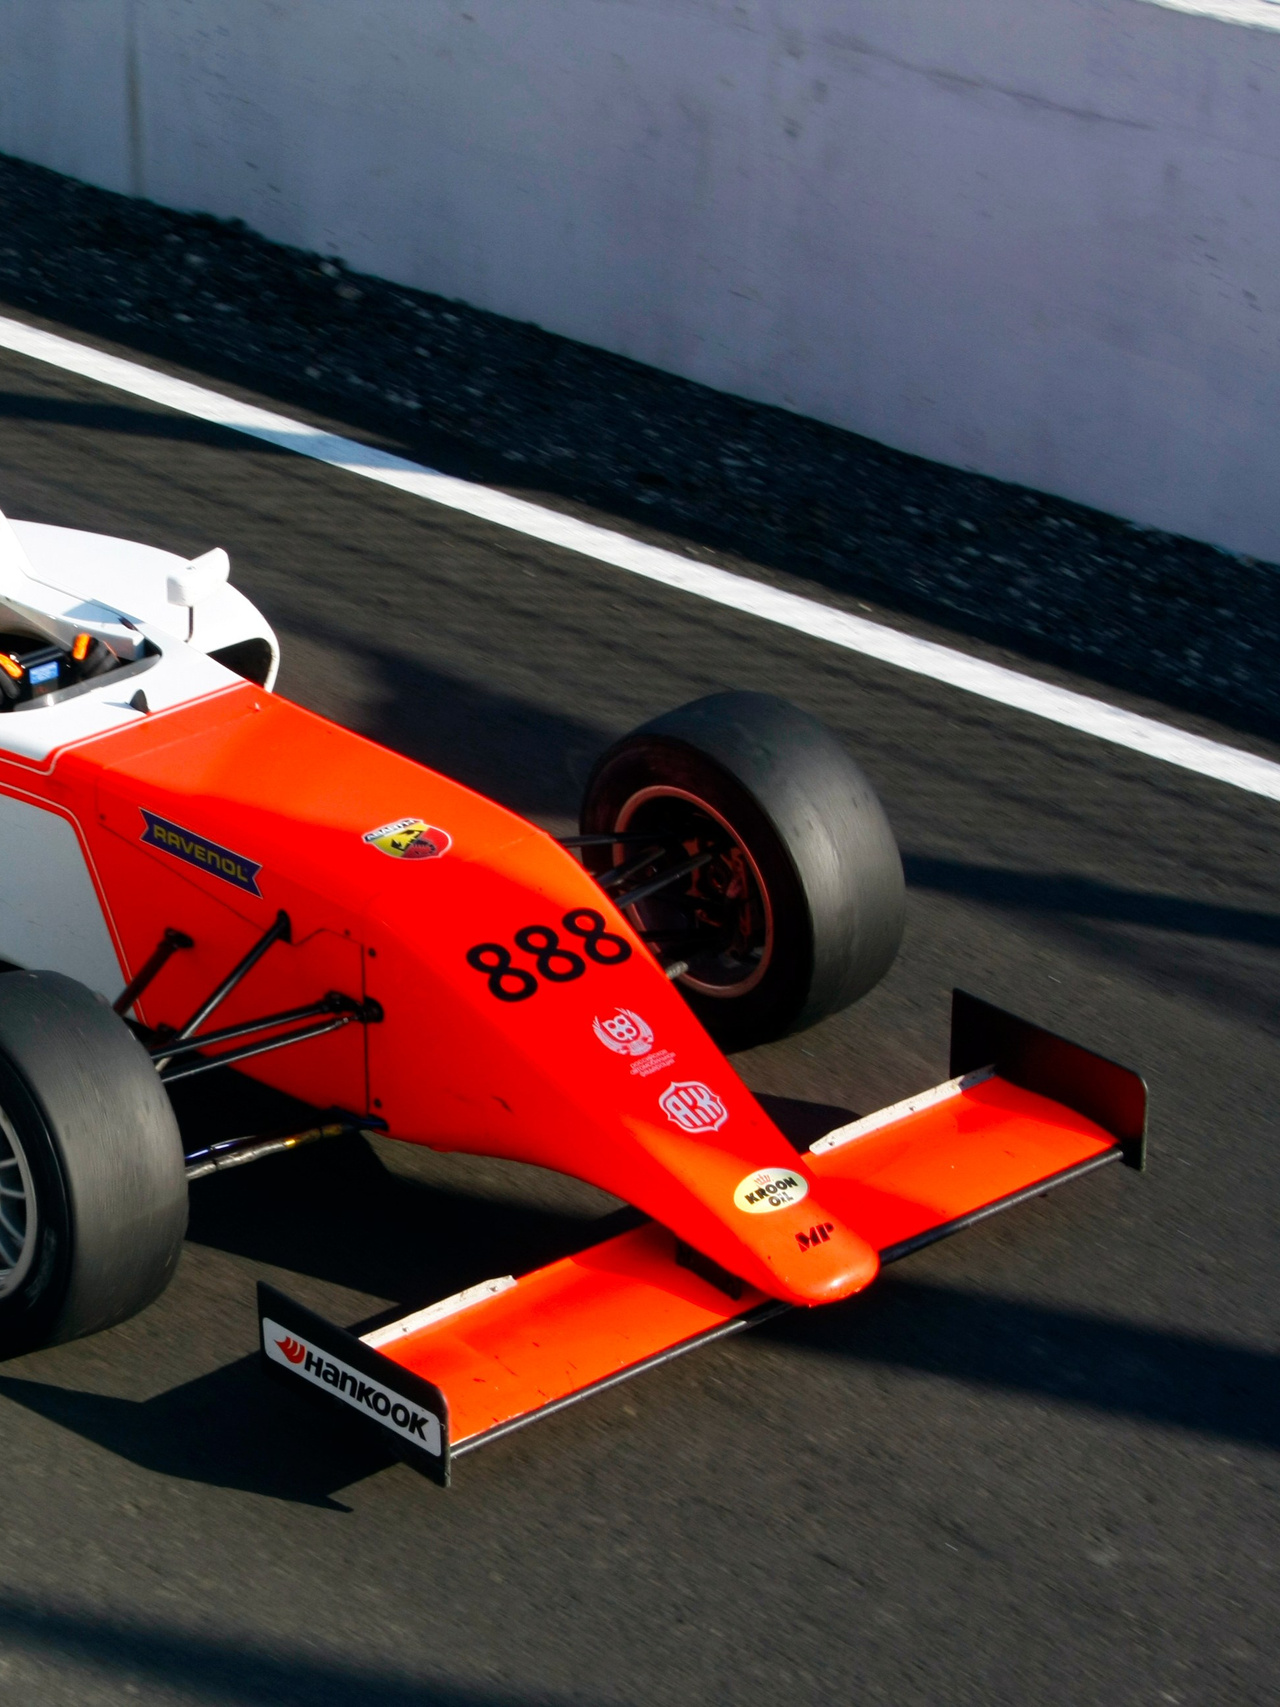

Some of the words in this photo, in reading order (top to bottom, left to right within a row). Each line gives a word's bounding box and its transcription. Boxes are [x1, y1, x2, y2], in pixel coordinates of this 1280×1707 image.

[153, 823, 249, 883] RAVENOL
[465, 907, 633, 1003] 888
[744, 1176, 798, 1205] KROON
